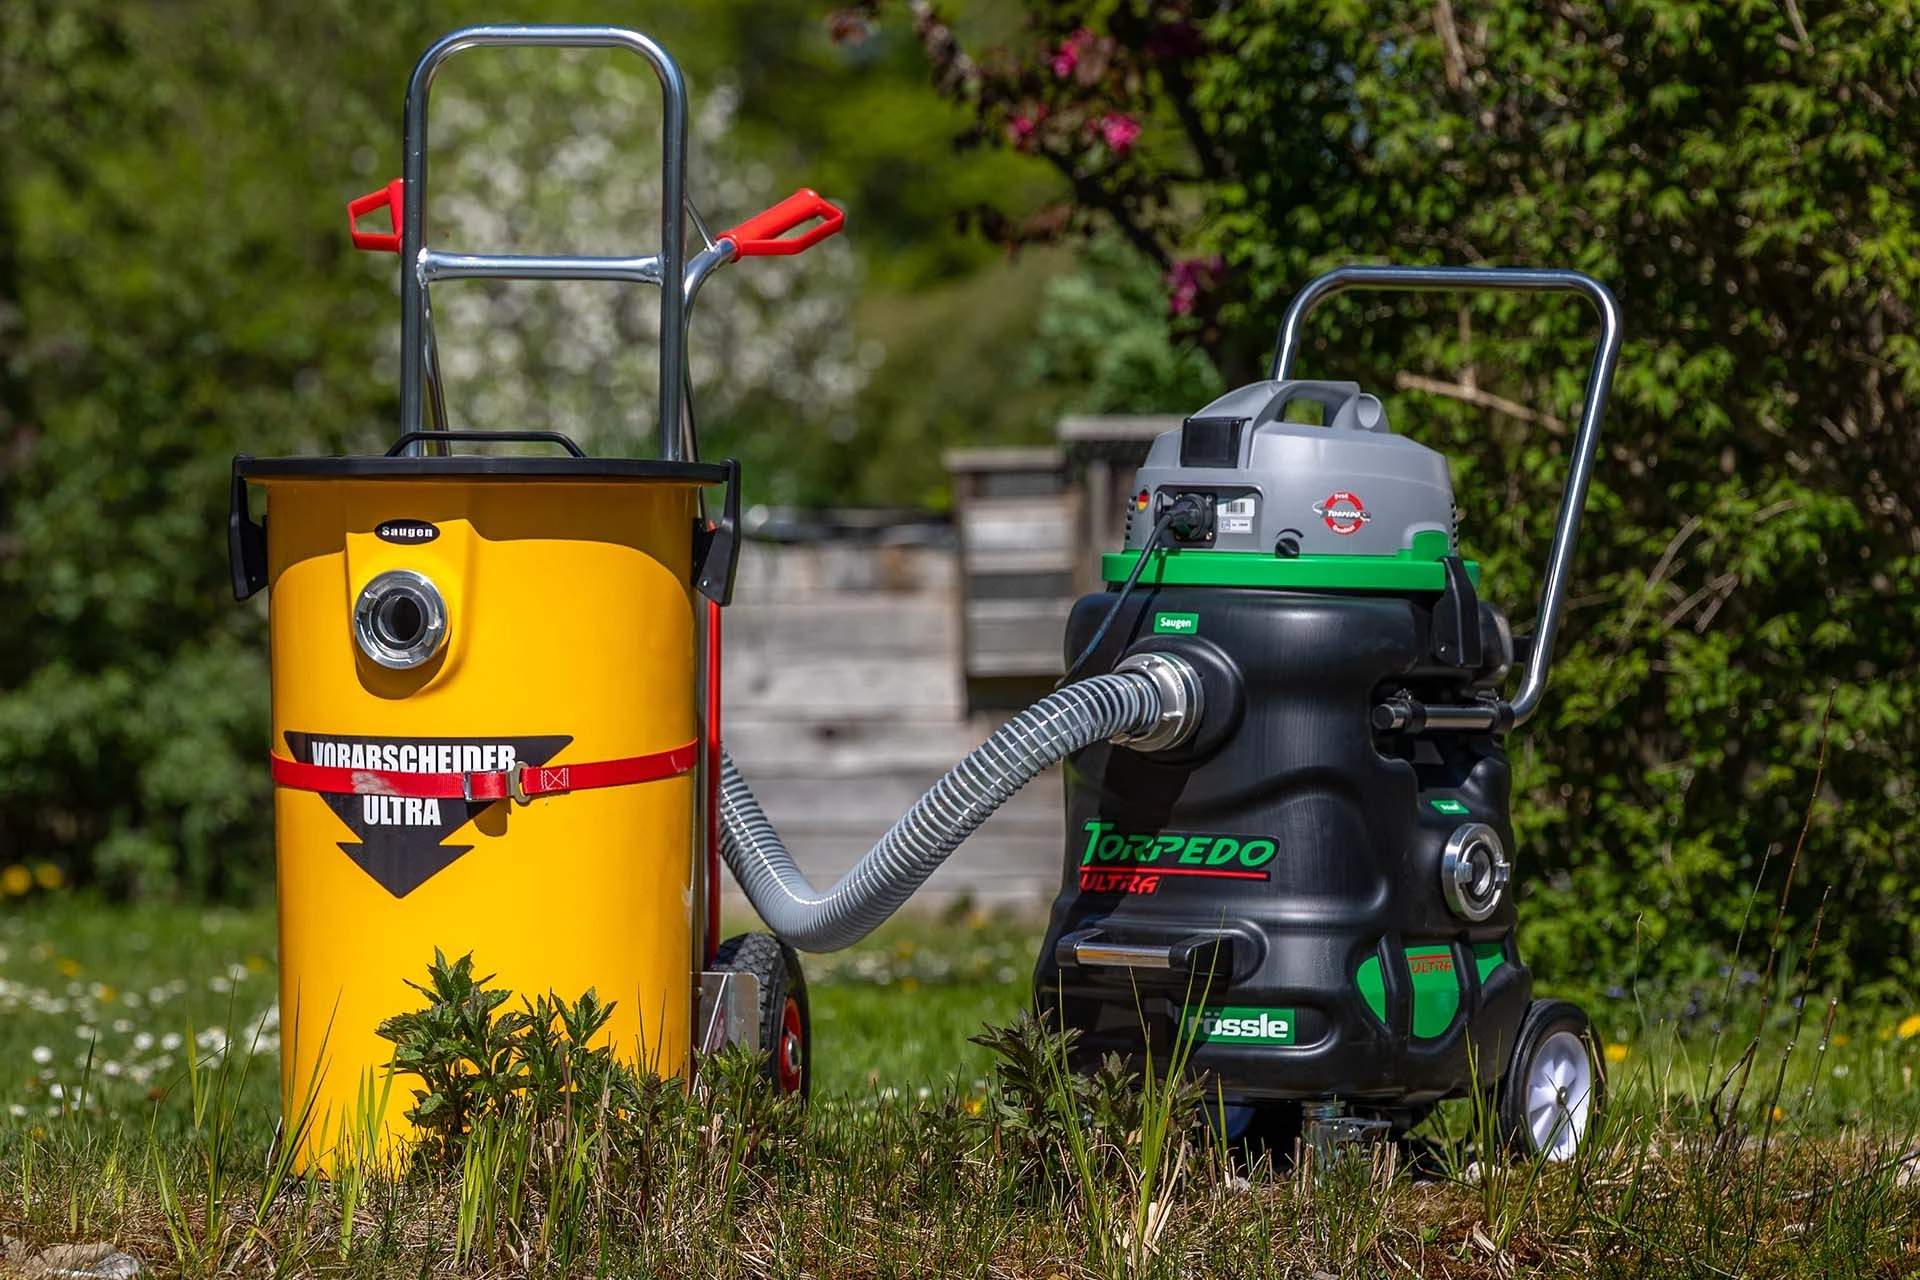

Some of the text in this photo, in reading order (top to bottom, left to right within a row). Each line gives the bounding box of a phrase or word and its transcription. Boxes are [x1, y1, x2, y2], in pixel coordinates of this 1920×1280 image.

[381, 526, 433, 538] Saugen
[1160, 616, 1192, 630] Saugen
[311, 741, 516, 773] VORABSCHEIDER
[363, 795, 442, 826] ULTRA
[1082, 822, 1275, 867] TORPEDO
[1080, 873, 1161, 895] ULTRA
[1411, 960, 1453, 974] ULTRA
[1188, 1011, 1289, 1039] rössle
